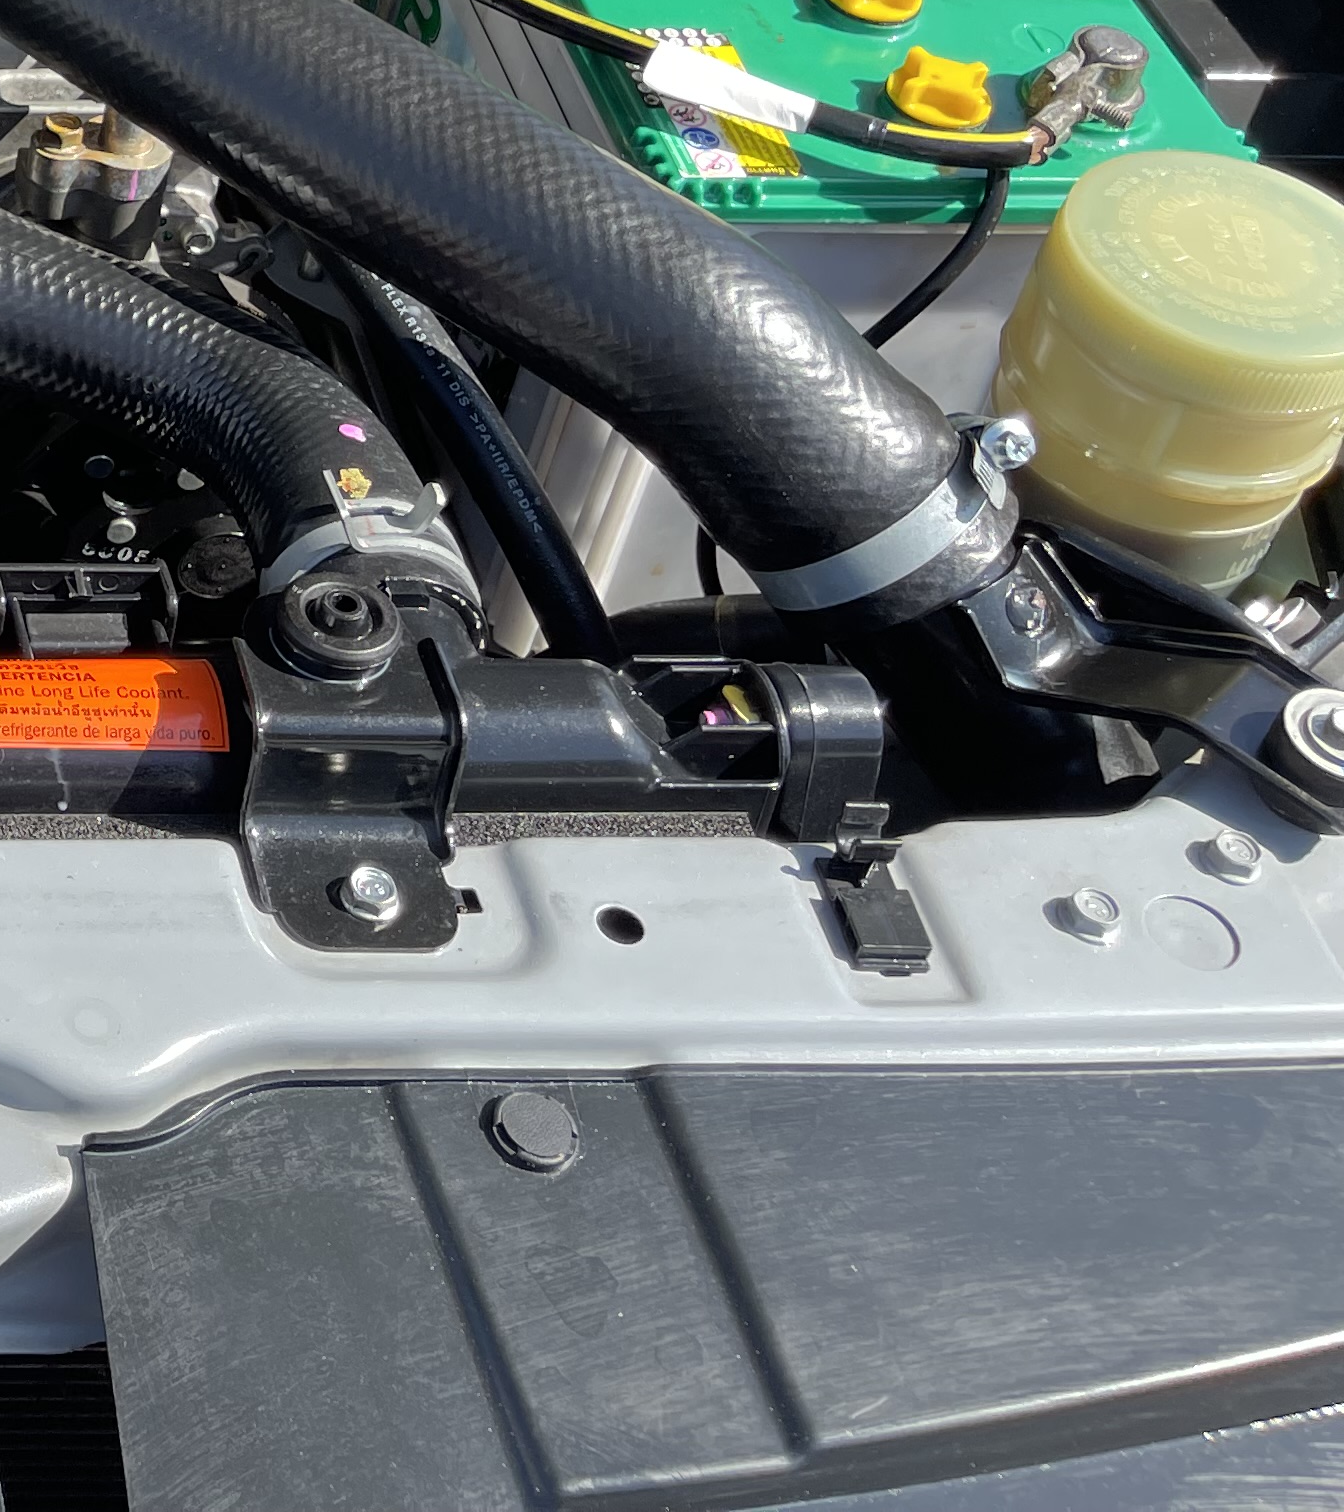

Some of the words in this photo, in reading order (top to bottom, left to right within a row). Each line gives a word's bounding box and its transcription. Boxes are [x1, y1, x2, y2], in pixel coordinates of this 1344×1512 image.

[381, 283, 408, 316] FLEX
[31, 685, 74, 700] Long
[79, 685, 111, 698] Life
[117, 686, 190, 699] Coolant.
[83, 724, 100, 738] de
[105, 724, 141, 742] larga
[145, 726, 174, 739] vida
[179, 728, 216, 743] puro.
